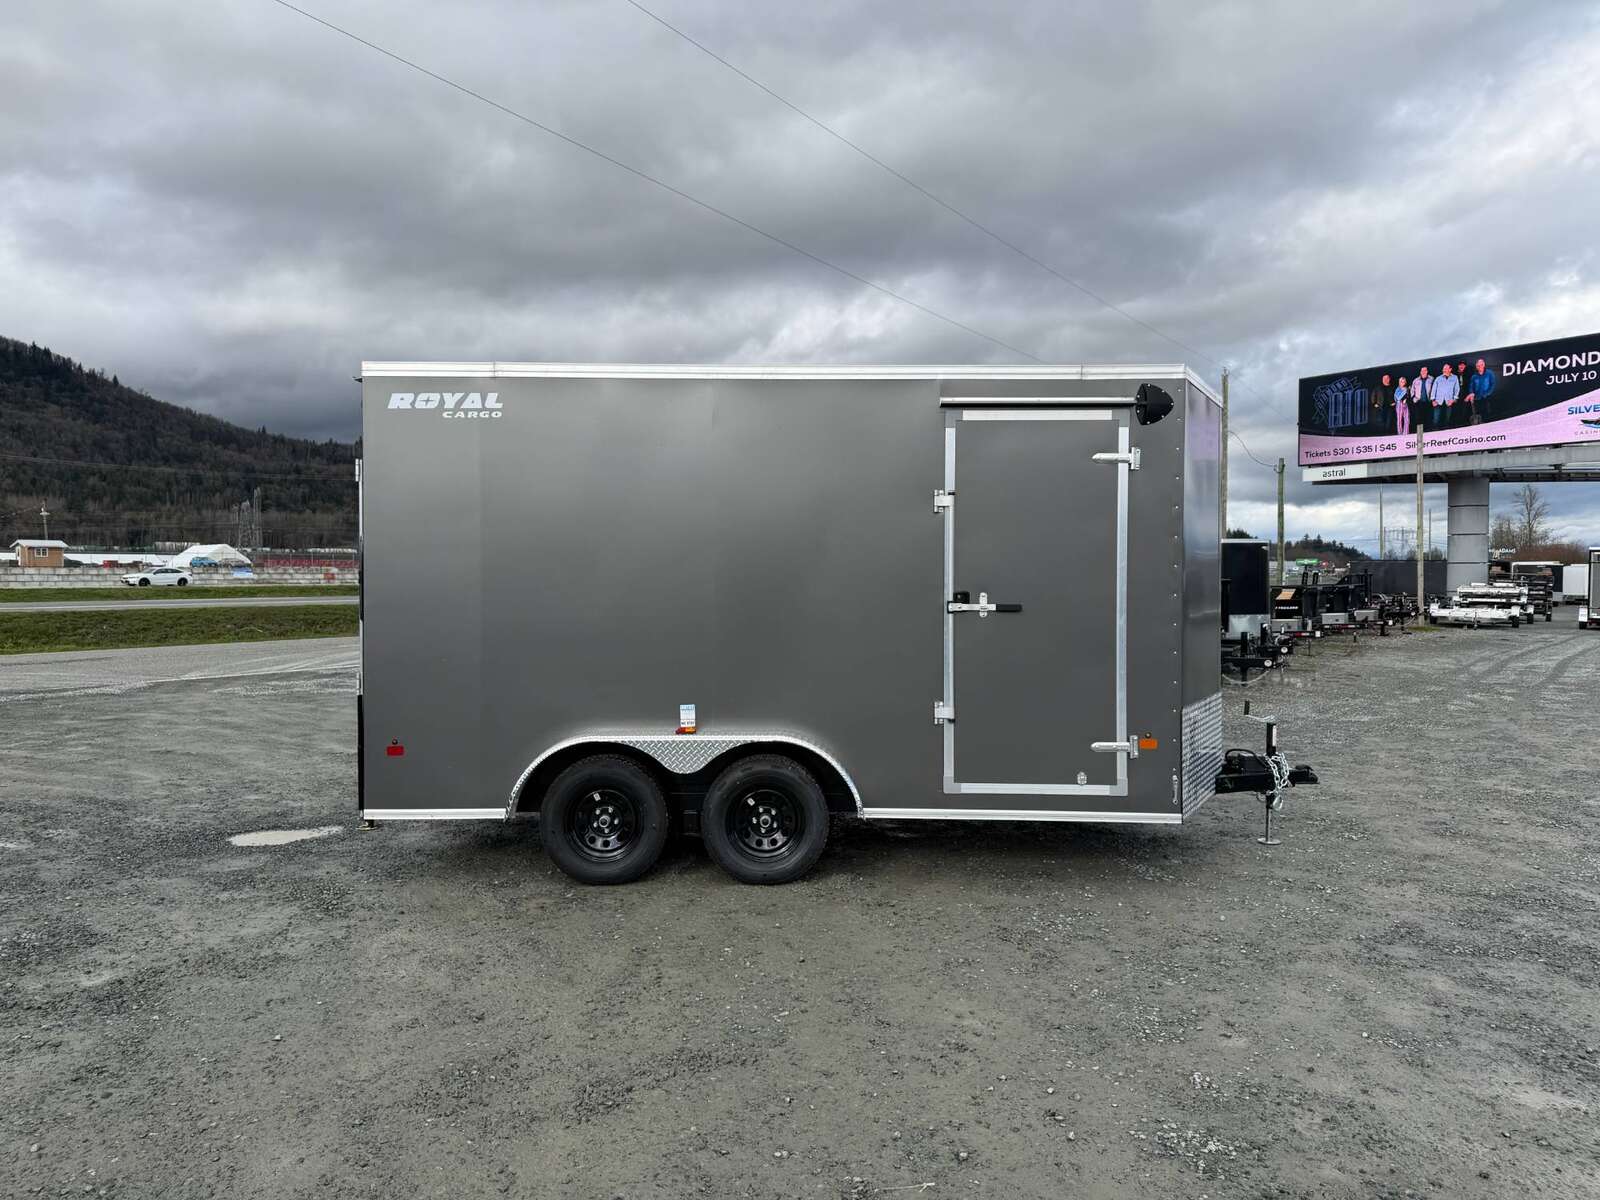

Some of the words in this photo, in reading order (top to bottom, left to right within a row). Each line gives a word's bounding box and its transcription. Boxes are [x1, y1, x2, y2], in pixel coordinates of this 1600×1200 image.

[1503, 351, 1600, 377] DIAMOND
[1546, 372, 1579, 385] JULY
[1582, 370, 1597, 381] 10
[387, 392, 503, 409] ROYAL
[1567, 404, 1600, 415] SILVE
[1305, 450, 1331, 459] Tickets
[1333, 447, 1350, 456] $30
[1356, 445, 1373, 454] $35
[1380, 443, 1397, 452] $45
[1322, 468, 1346, 478] astral
